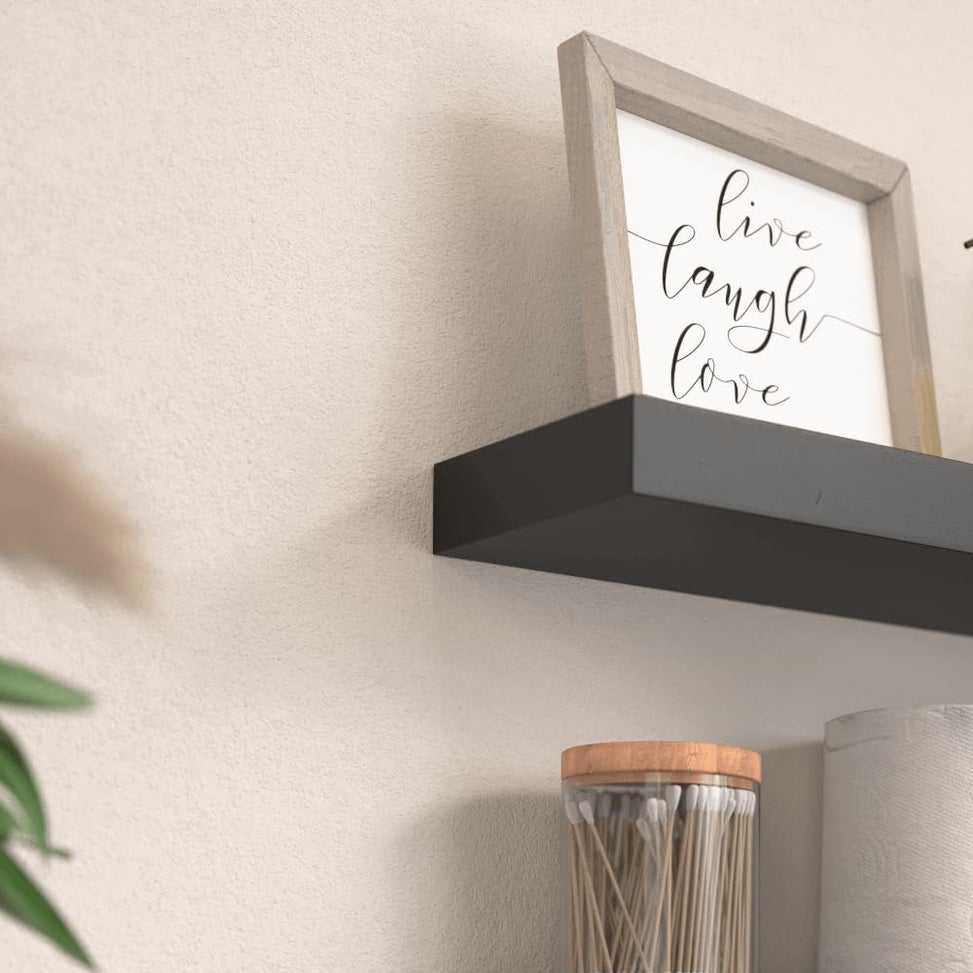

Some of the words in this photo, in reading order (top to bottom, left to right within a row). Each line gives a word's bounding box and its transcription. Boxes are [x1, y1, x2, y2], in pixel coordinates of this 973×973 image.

[716, 169, 823, 251] live
[655, 223, 842, 354] laugh
[670, 323, 791, 406] love
